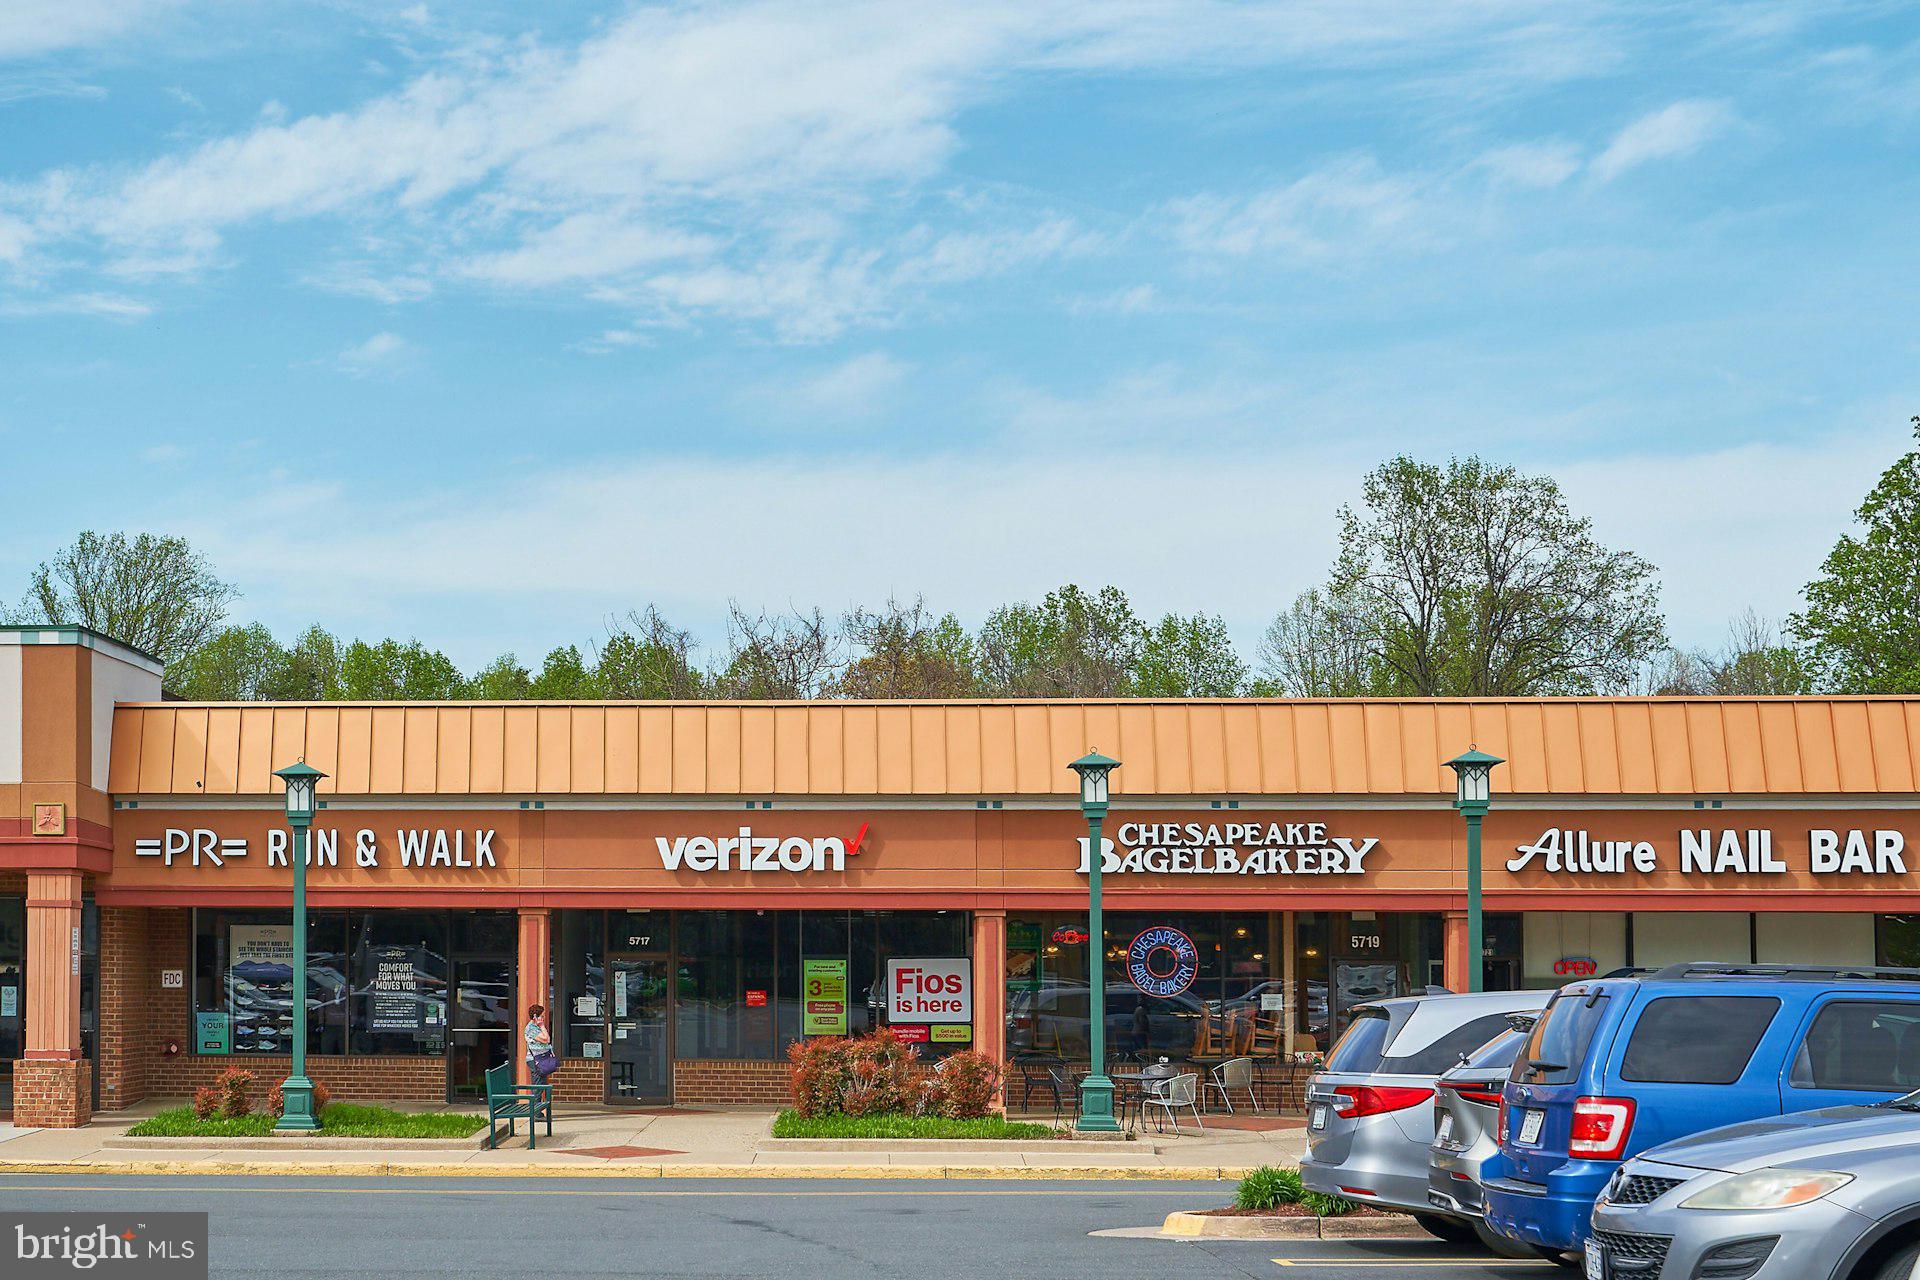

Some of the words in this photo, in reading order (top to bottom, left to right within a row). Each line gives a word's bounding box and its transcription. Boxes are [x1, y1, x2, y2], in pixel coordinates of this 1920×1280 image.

[1117, 822, 1329, 847] CHESAPEAKE
[355, 828, 379, 867] &
[397, 829, 497, 867] WALK
[654, 826, 846, 872] verizon
[1506, 827, 1657, 873] Allure
[1680, 829, 1787, 873] NAIL
[1810, 829, 1908, 874] BAR
[628, 936, 650, 945] 5717
[1131, 930, 1194, 960] CHESAPEAKE
[1351, 935, 1380, 948] 5719
[378, 962, 413, 972] COMFORT
[1553, 960, 1597, 976] OPEN
[164, 973, 181, 985] FDC
[378, 972, 393, 981] FOR
[393, 972, 414, 981] WHAT
[896, 967, 963, 994] Fios
[1130, 963, 1156, 993] BAGEL
[1160, 963, 1194, 995] BAKERY
[375, 981, 401, 990] MOVES
[401, 981, 417, 990] YOU
[809, 979, 822, 996] 3
[896, 996, 913, 1013] is
[916, 995, 963, 1013] here
